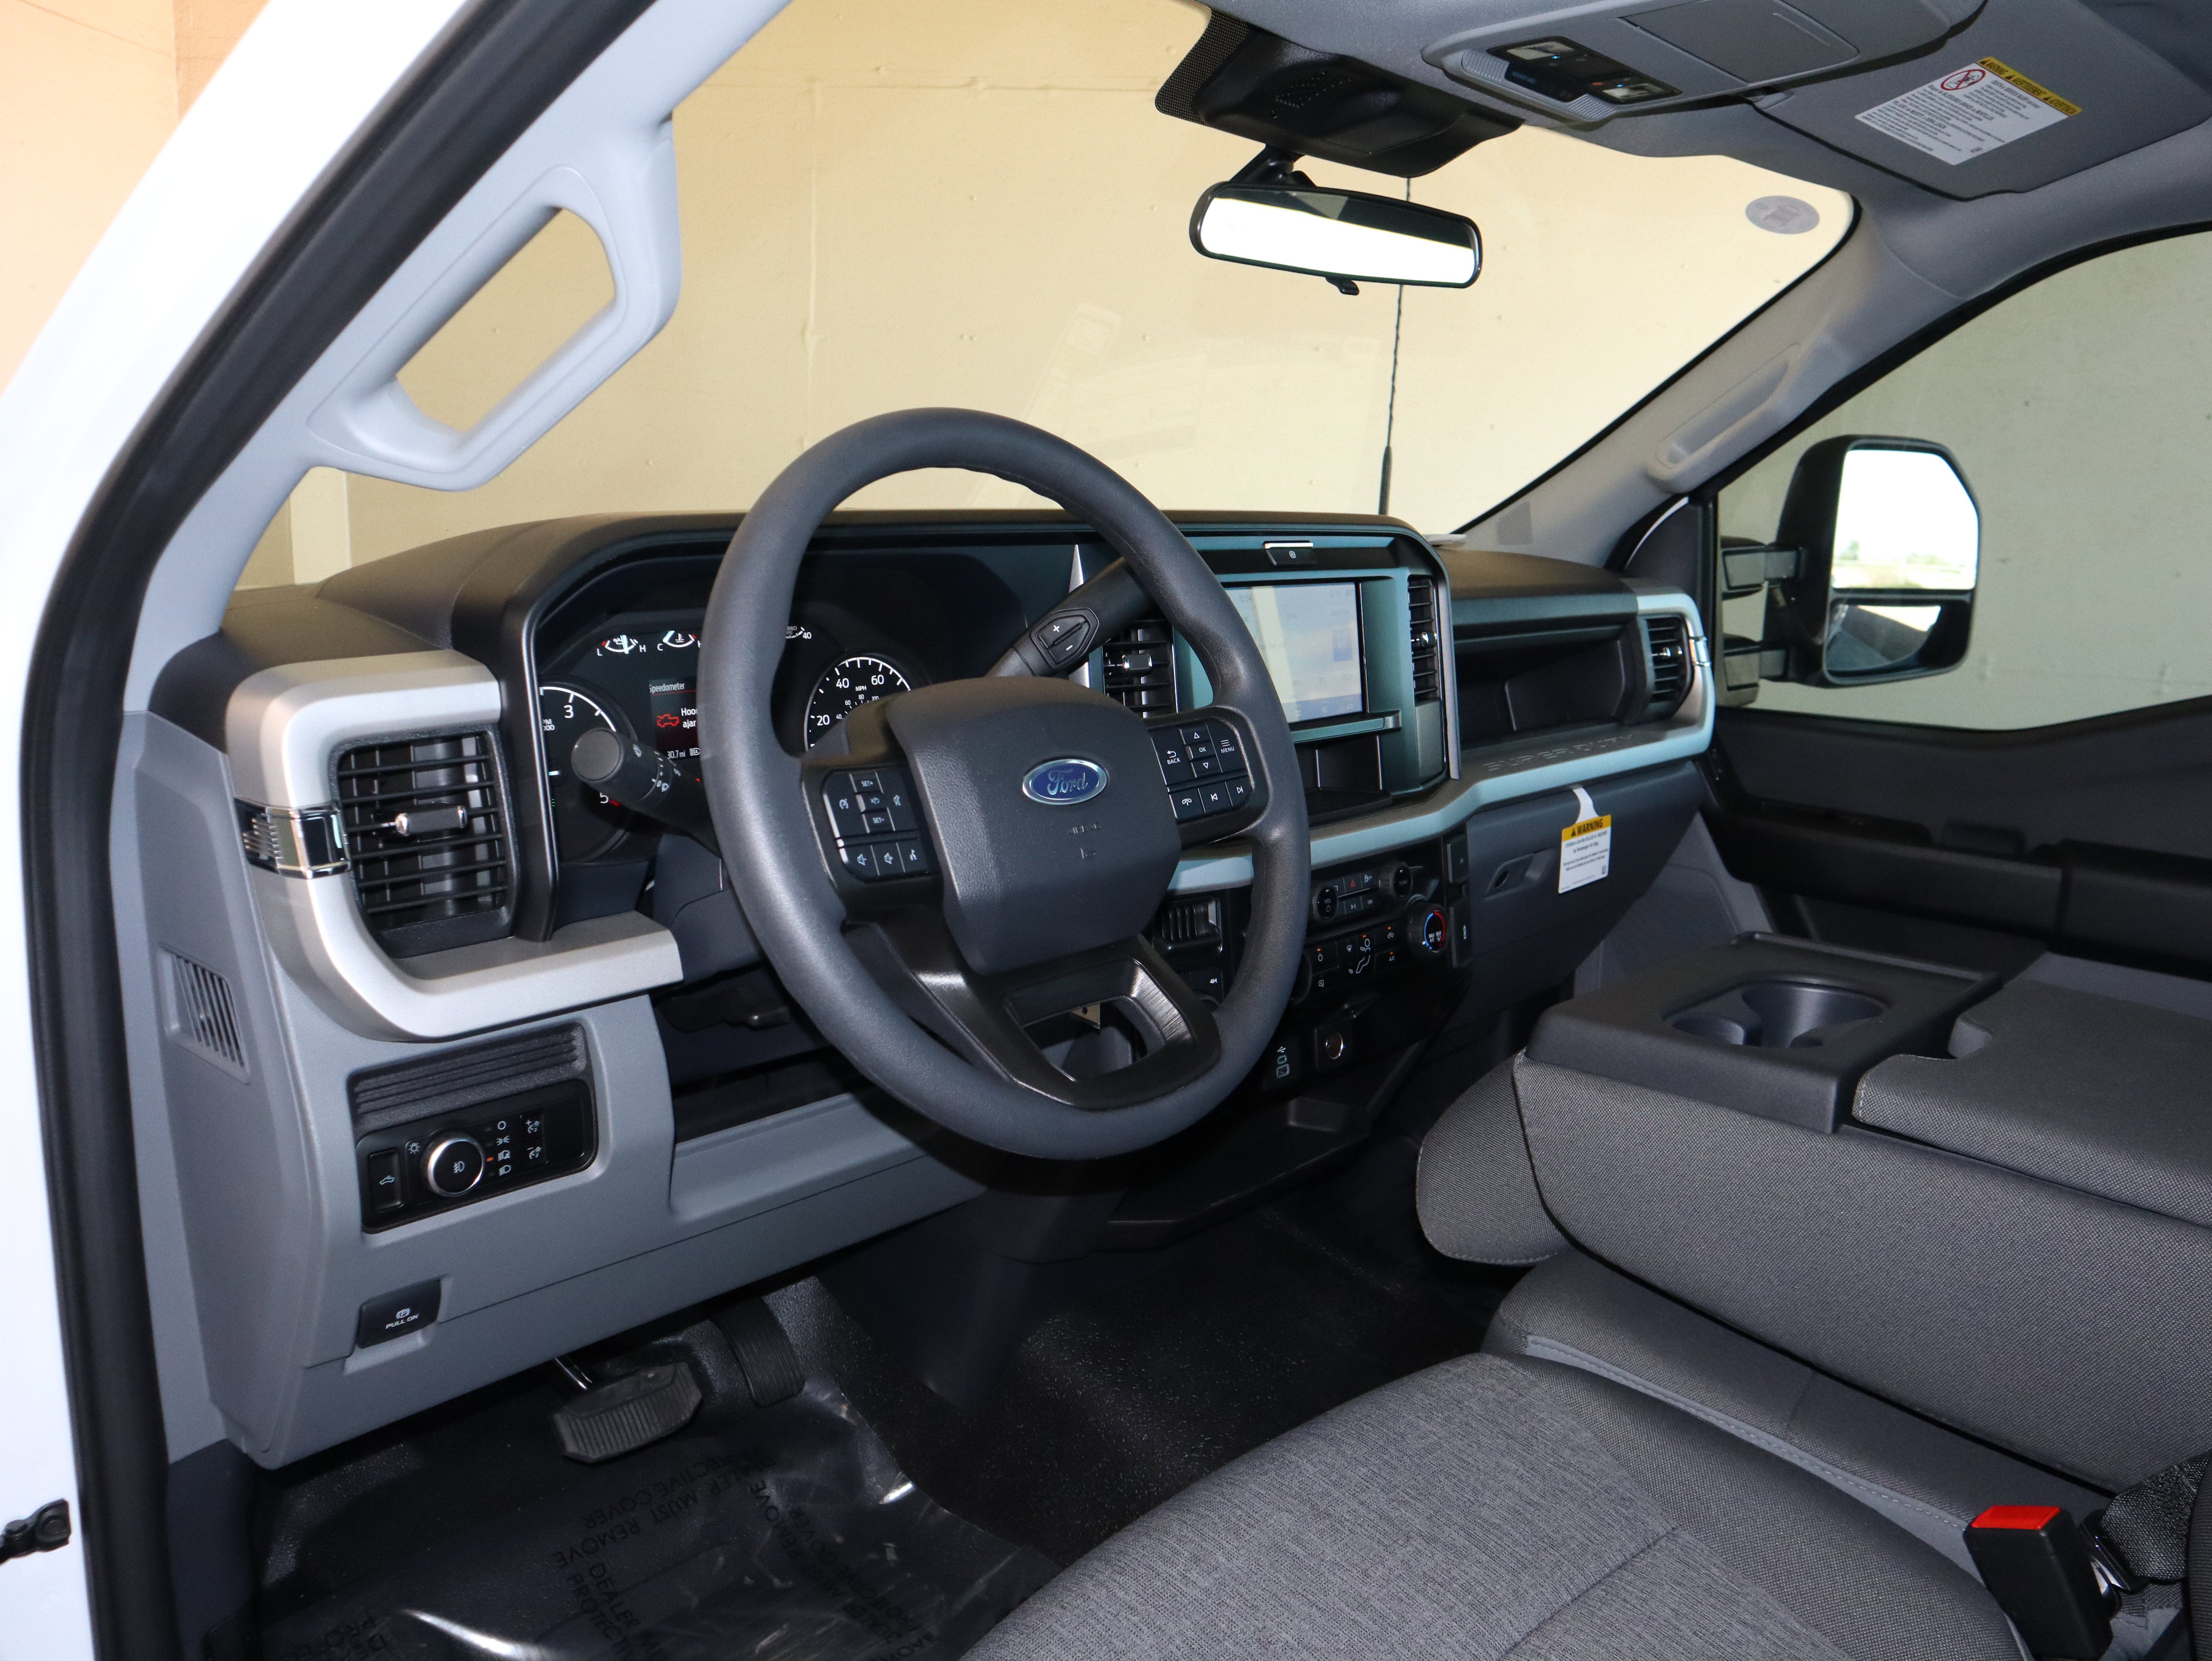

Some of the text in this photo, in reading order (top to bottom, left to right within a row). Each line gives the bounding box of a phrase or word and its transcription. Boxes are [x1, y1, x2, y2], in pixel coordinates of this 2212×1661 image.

[836, 678, 849, 689] 40
[871, 674, 884, 685] 60
[649, 683, 685, 694] Speedometer
[564, 705, 573, 718] 3
[683, 720, 697, 729] ajar
[817, 715, 830, 726] 20
[1047, 769, 1088, 796] Ford
[1577, 818, 1603, 835] WARNING
[385, 1313, 419, 1329] PULL ON
[582, 1490, 652, 1530] COVER
[650, 1490, 699, 1524] MUST
[749, 1480, 803, 1560] REMOVE
[553, 1518, 641, 1569] REMOVE
[588, 1563, 640, 1627] DEALER
